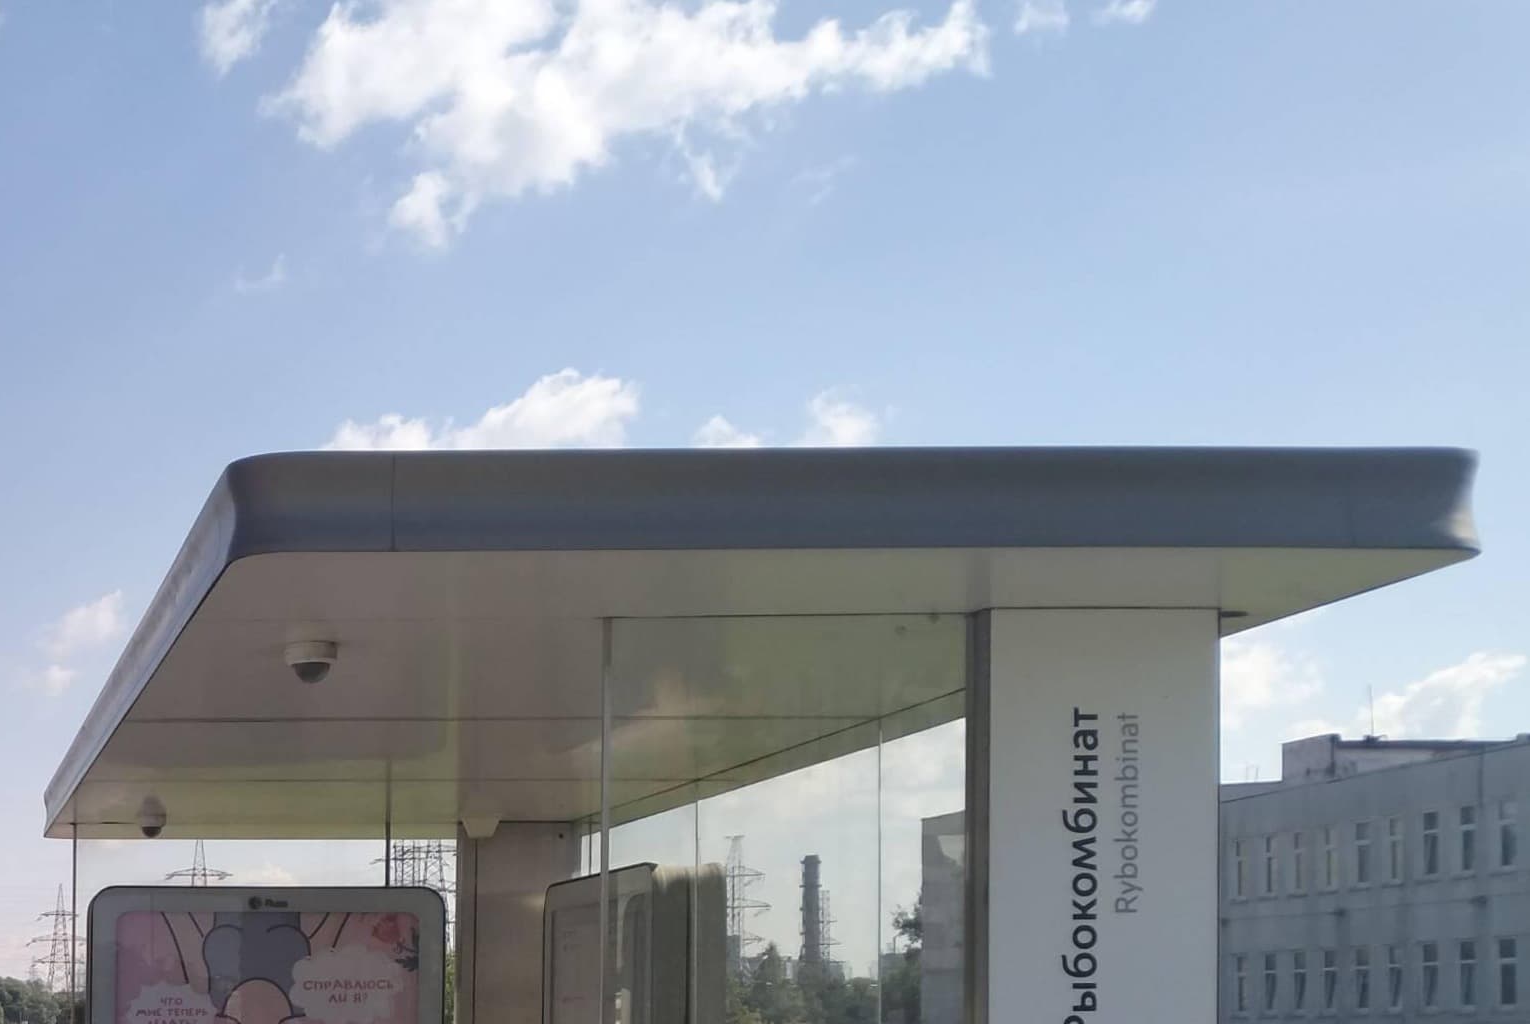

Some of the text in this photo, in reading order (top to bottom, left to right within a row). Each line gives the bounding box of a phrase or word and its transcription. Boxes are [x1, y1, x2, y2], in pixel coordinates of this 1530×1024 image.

[1113, 712, 1143, 914] Rybokombinat
[160, 996, 183, 1006] ЧТО
[135, 1007, 208, 1017] МНЕ ТЕПЕРЬ
